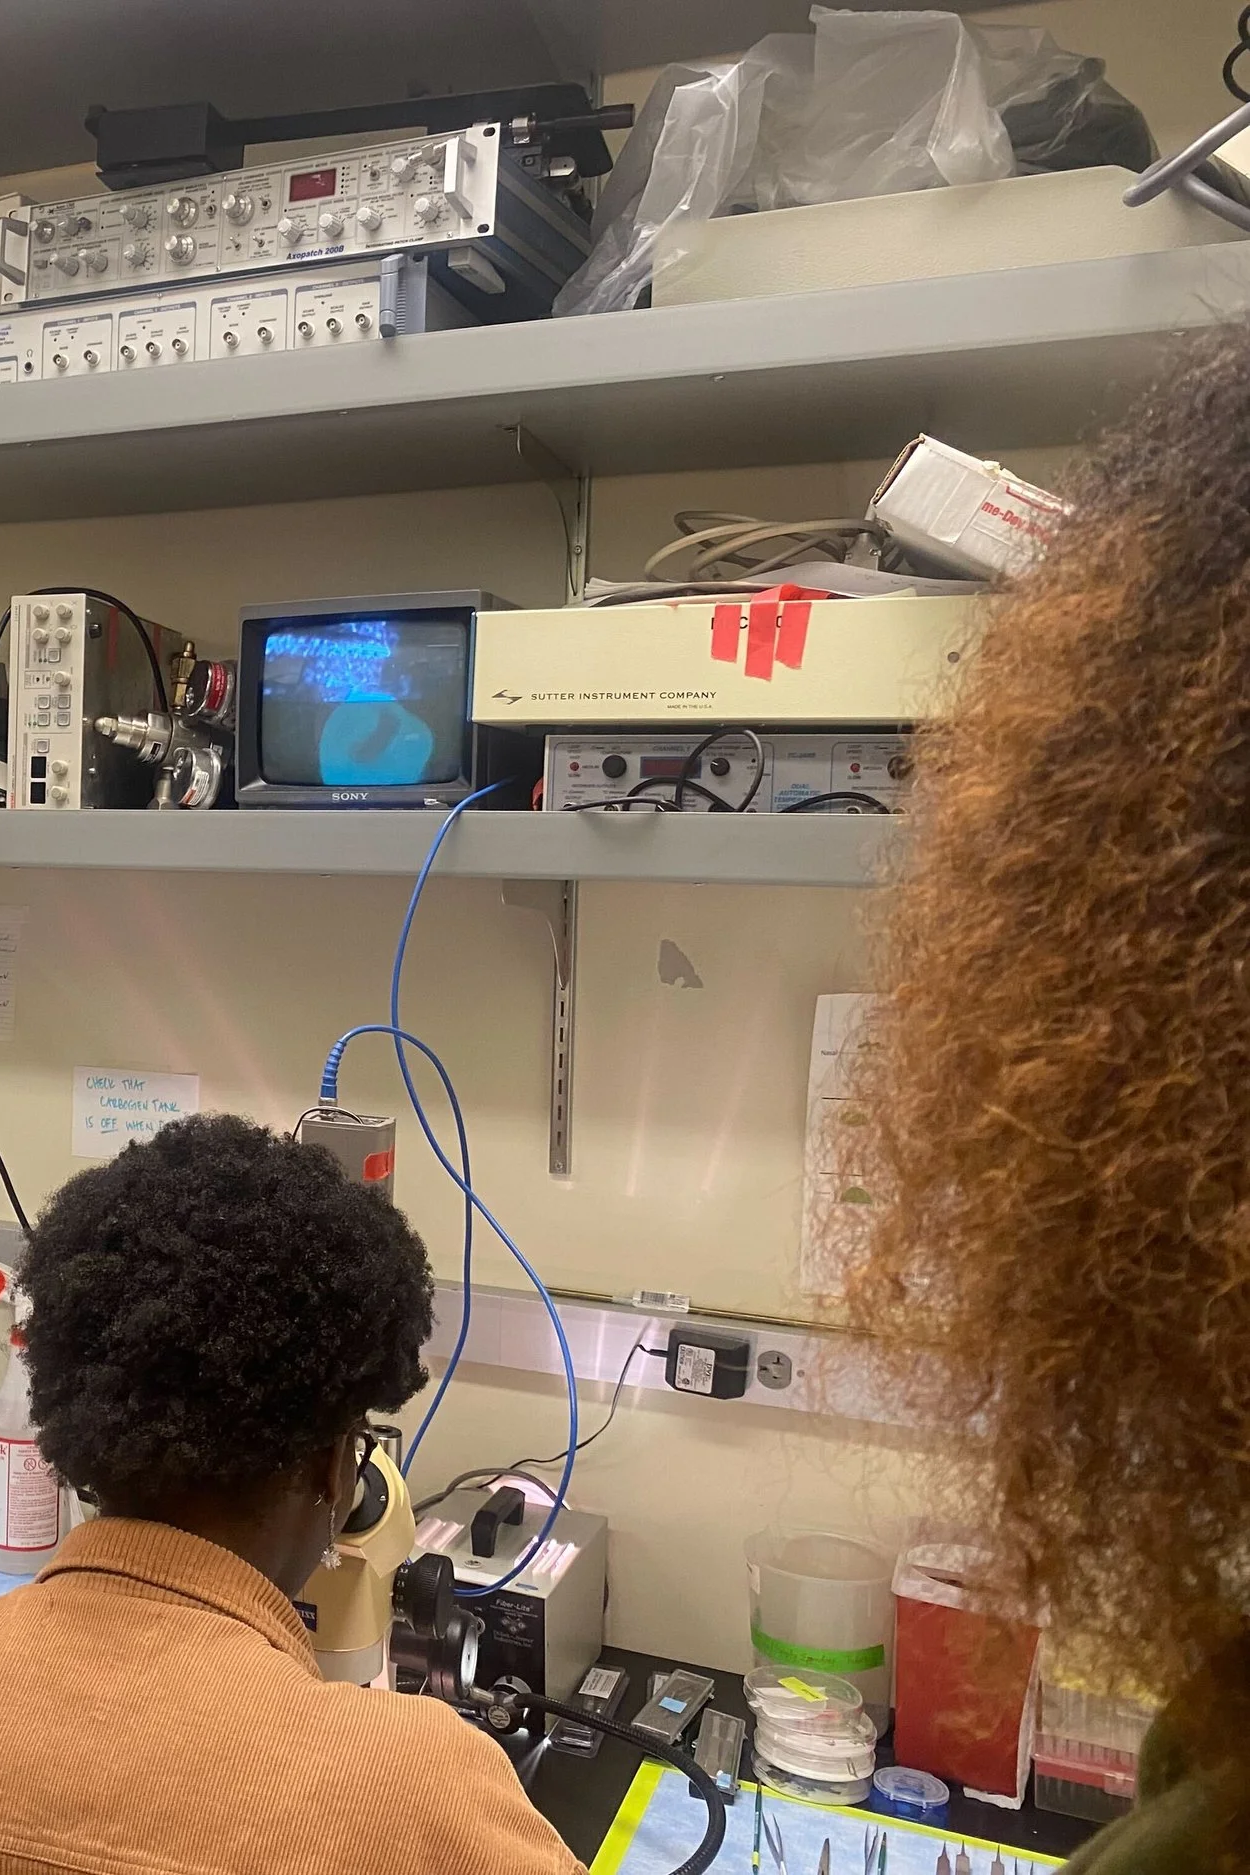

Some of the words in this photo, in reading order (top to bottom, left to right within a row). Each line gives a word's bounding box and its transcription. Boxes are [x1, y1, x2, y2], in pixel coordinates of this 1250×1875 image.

[286, 247, 323, 260] Axopatch
[531, 692, 575, 701] SUTTER
[579, 692, 656, 701] INSTRUMENT
[659, 690, 717, 700] COMPANY
[332, 792, 369, 801] SONY
[86, 1077, 116, 1090] CHECK
[122, 1079, 147, 1091] THAT
[100, 1096, 148, 1111] CARBOGEN
[151, 1098, 180, 1112] TANK
[85, 1116, 94, 1129] IS
[100, 1117, 118, 1131] OFF
[125, 1119, 153, 1132] WHEN
[495, 1598, 530, 1612] Fiber-Lite
